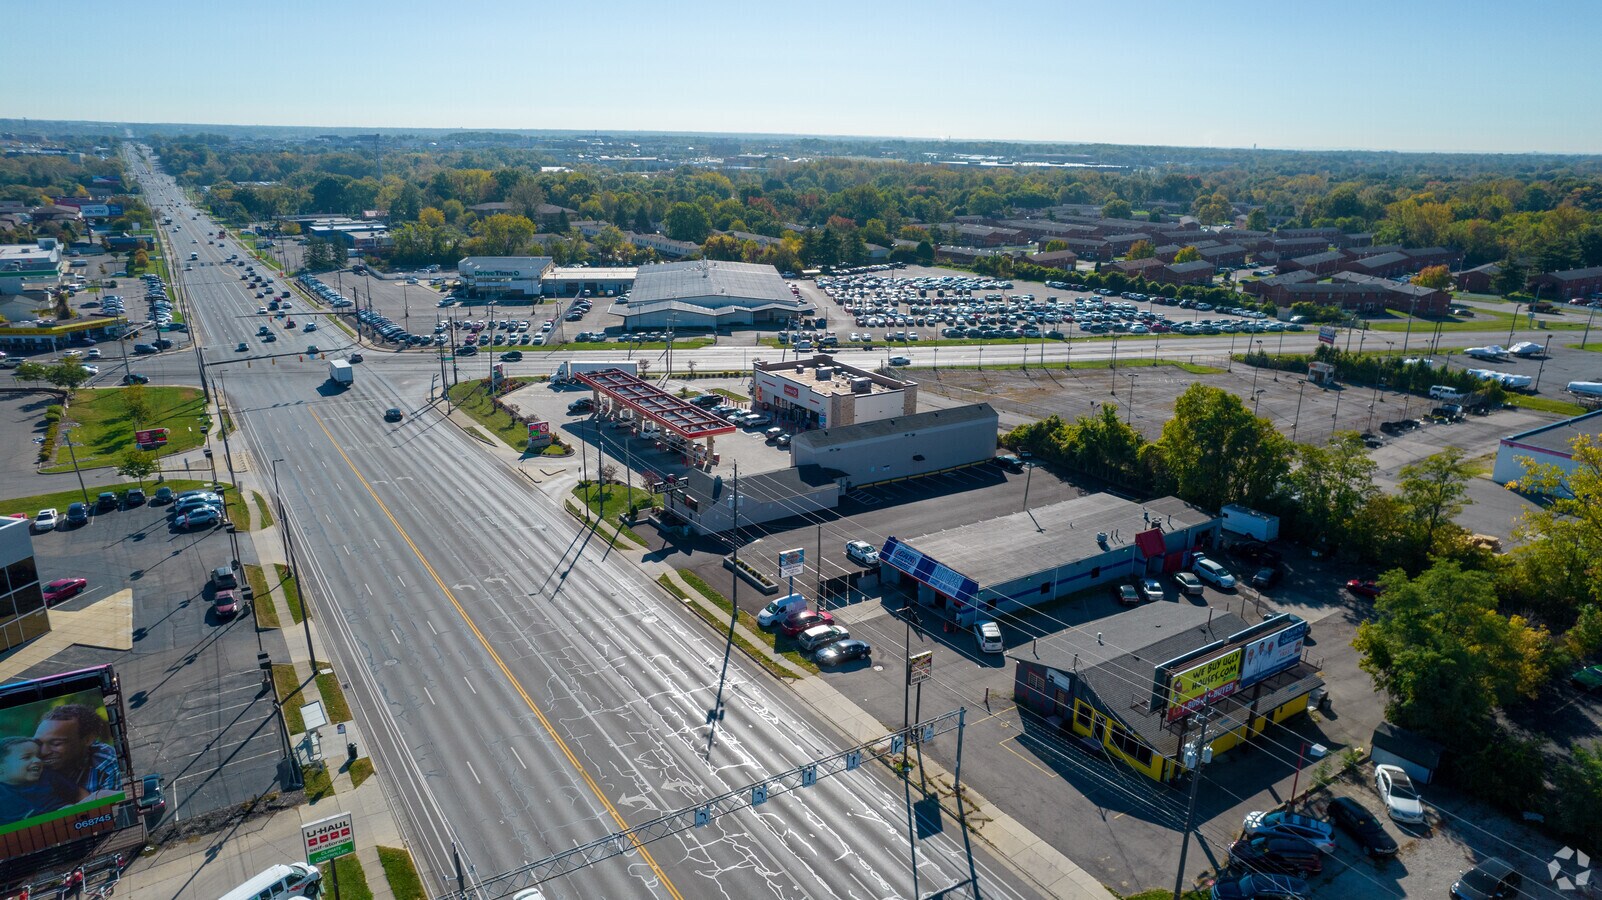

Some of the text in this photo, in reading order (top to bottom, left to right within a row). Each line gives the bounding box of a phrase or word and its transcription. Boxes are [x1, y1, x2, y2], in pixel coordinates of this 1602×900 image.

[1193, 667, 1206, 678] WE
[1208, 660, 1222, 674] BUY
[1222, 652, 1240, 666] UGLY
[1192, 664, 1236, 690] HOUSES.COM
[74, 814, 111, 830] 068745
[306, 821, 349, 838] U-HAUL
[310, 837, 352, 852] self-storage
[320, 846, 342, 856] CLIMATE
[316, 848, 349, 862] CONTROLLED
